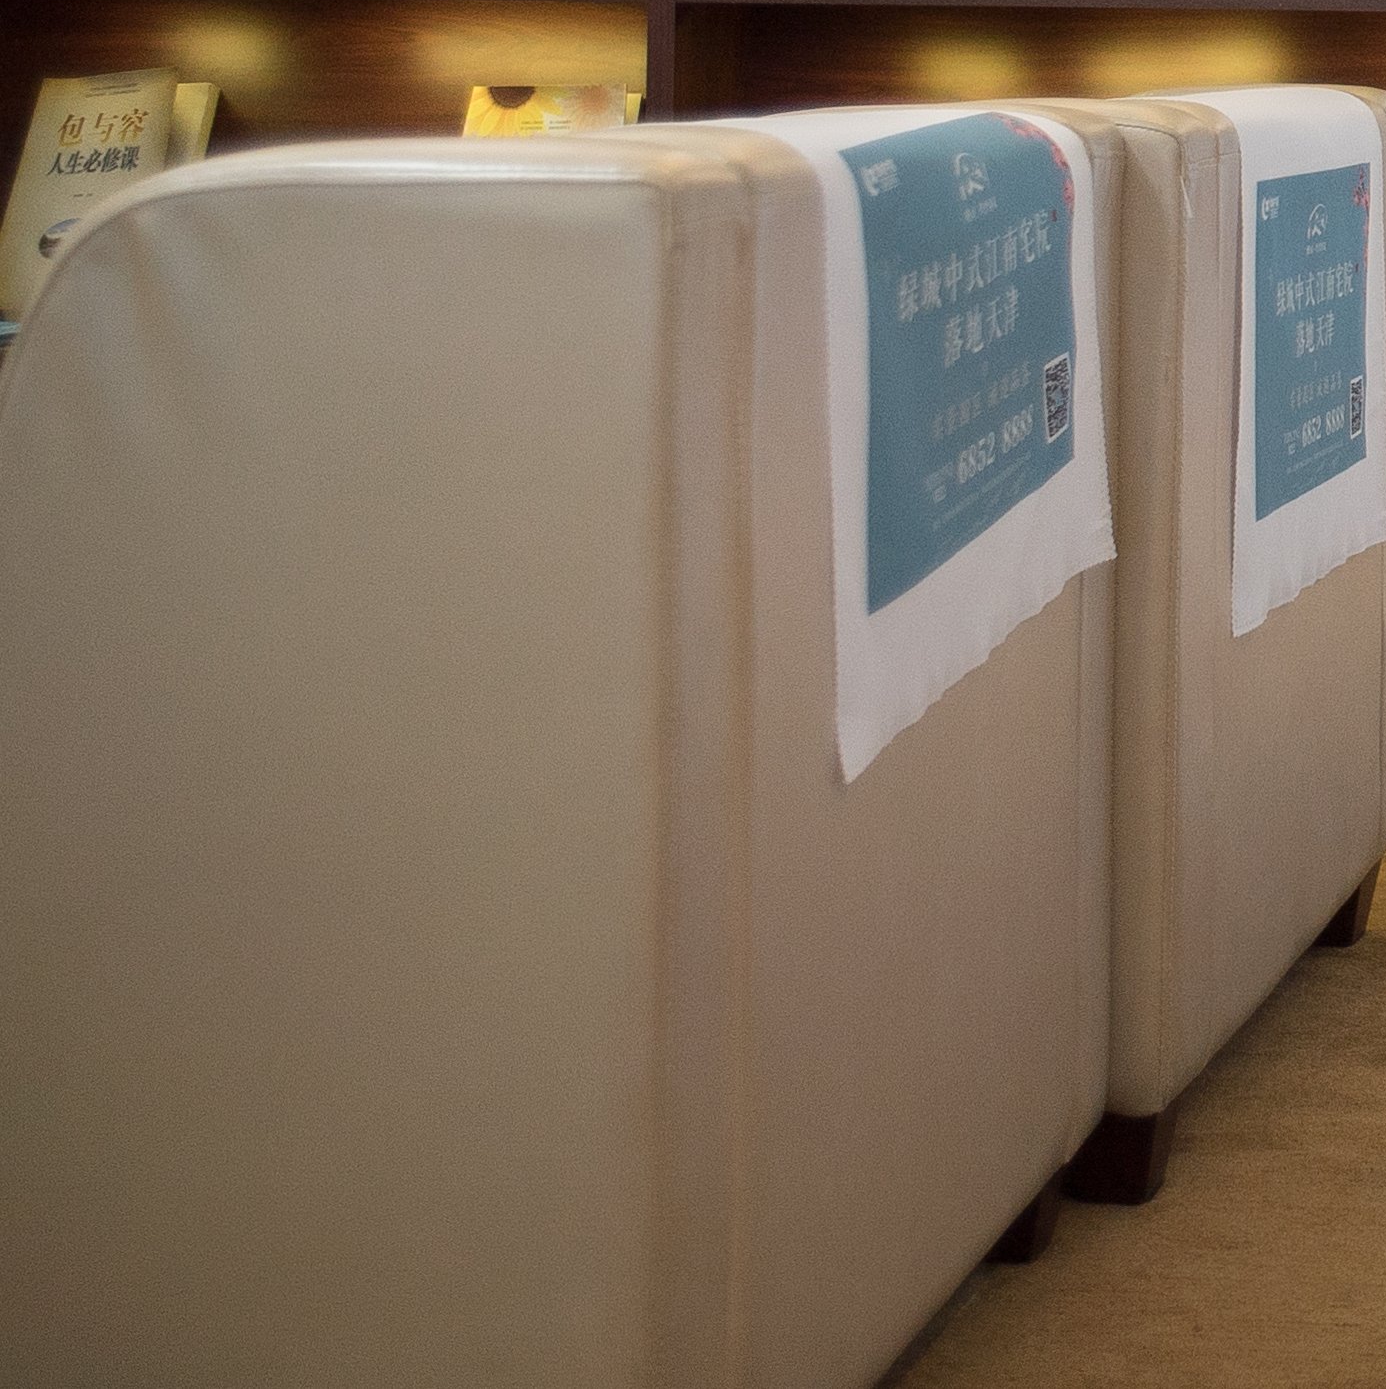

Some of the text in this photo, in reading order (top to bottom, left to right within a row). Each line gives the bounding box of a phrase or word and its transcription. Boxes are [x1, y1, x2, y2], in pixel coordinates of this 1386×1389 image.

[57, 107, 149, 148] 包与容
[47, 145, 140, 176] 人生必修课
